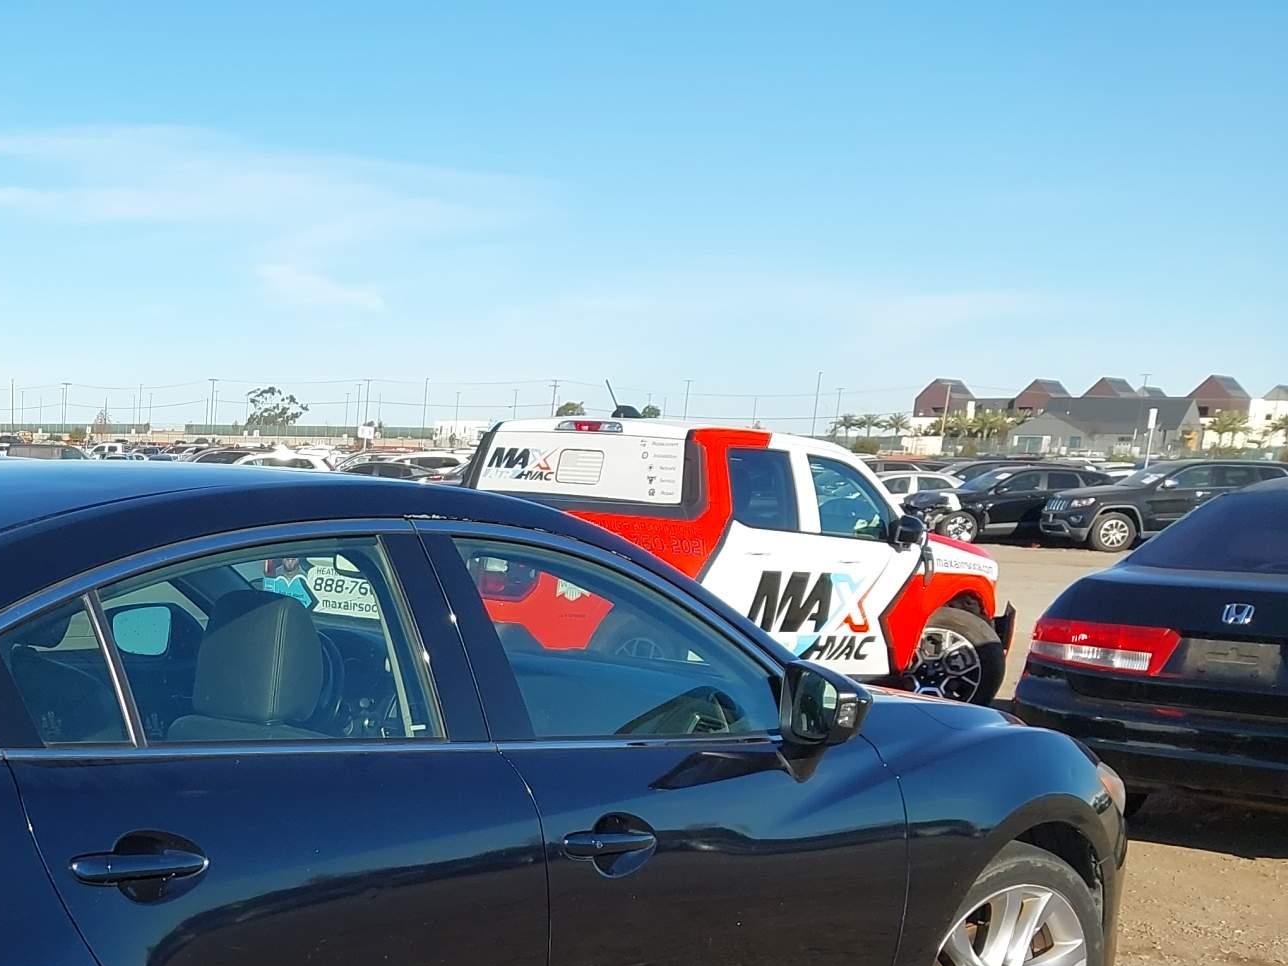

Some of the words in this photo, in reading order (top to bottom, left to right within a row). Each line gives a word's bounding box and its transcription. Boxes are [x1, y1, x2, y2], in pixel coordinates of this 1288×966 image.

[487, 447, 556, 470] MAX
[515, 470, 555, 481] HVAC
[747, 570, 884, 633] MAX
[799, 635, 877, 660] HVAC
